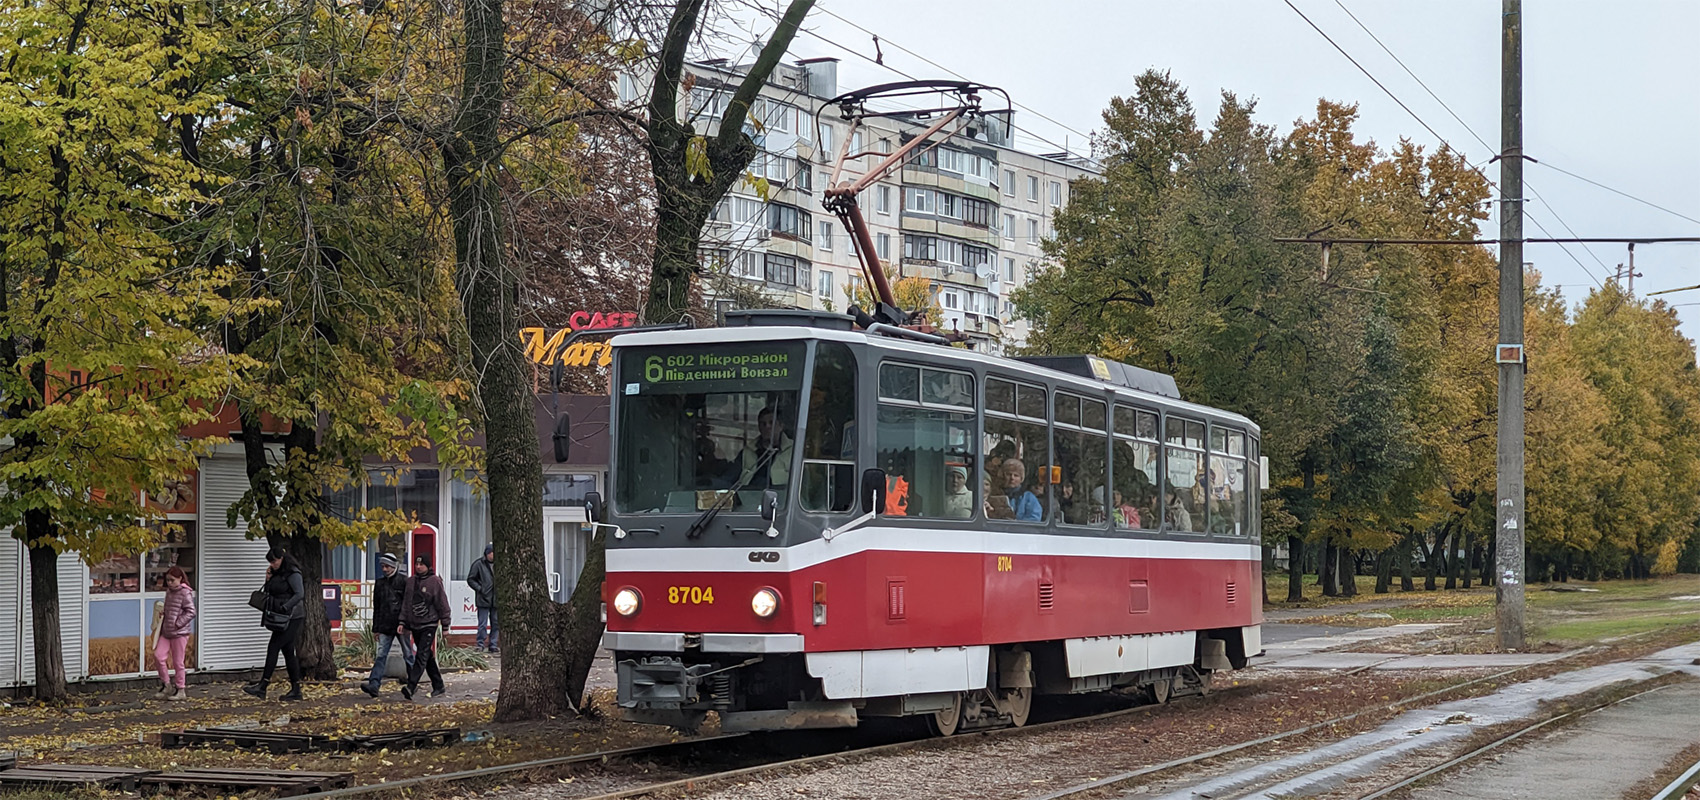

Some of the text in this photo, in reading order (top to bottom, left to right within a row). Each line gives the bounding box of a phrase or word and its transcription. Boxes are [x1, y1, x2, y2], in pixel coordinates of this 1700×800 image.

[667, 352, 788, 367] 602 Мікрорайон
[645, 355, 664, 383] 6
[665, 366, 788, 382] Південний Вокзал
[997, 556, 1013, 572] 8704
[668, 586, 714, 604] 8704
